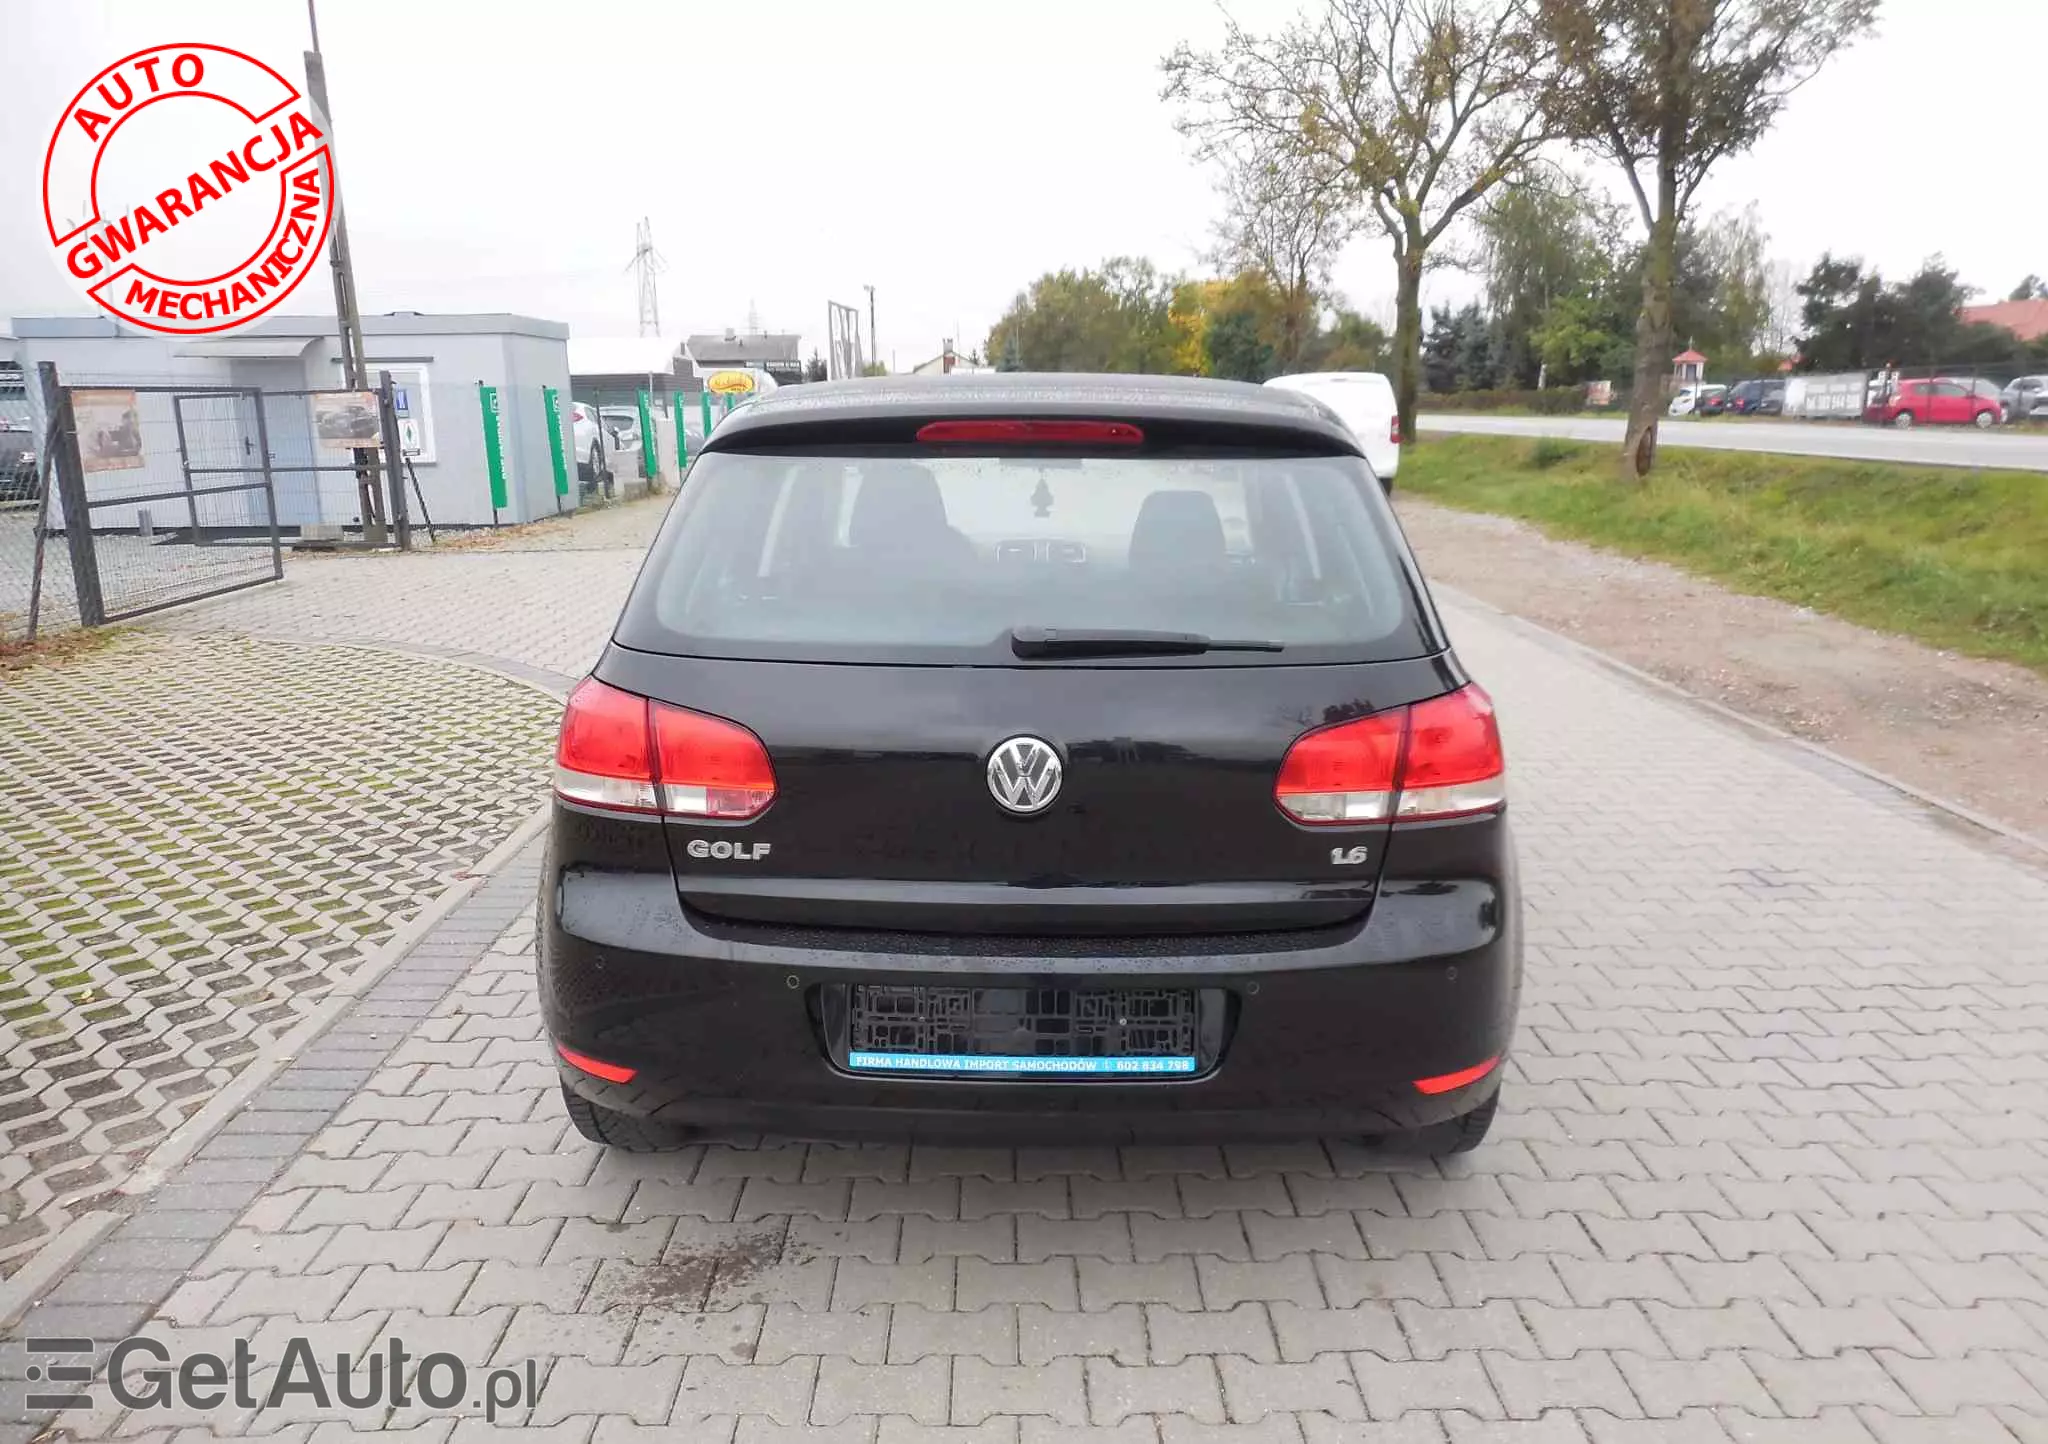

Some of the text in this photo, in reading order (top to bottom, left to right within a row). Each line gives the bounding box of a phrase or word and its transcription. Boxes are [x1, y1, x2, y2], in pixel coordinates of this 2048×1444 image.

[686, 839, 772, 861] GOLF
[856, 1056, 890, 1067] FIRMA
[895, 1057, 961, 1069] HANDLOWA
[965, 1059, 1009, 1070] IMPORT
[1013, 1058, 1097, 1071] SAMOCHODÓW
[1117, 1060, 1139, 1071] 602
[1167, 1060, 1189, 1071] 798
